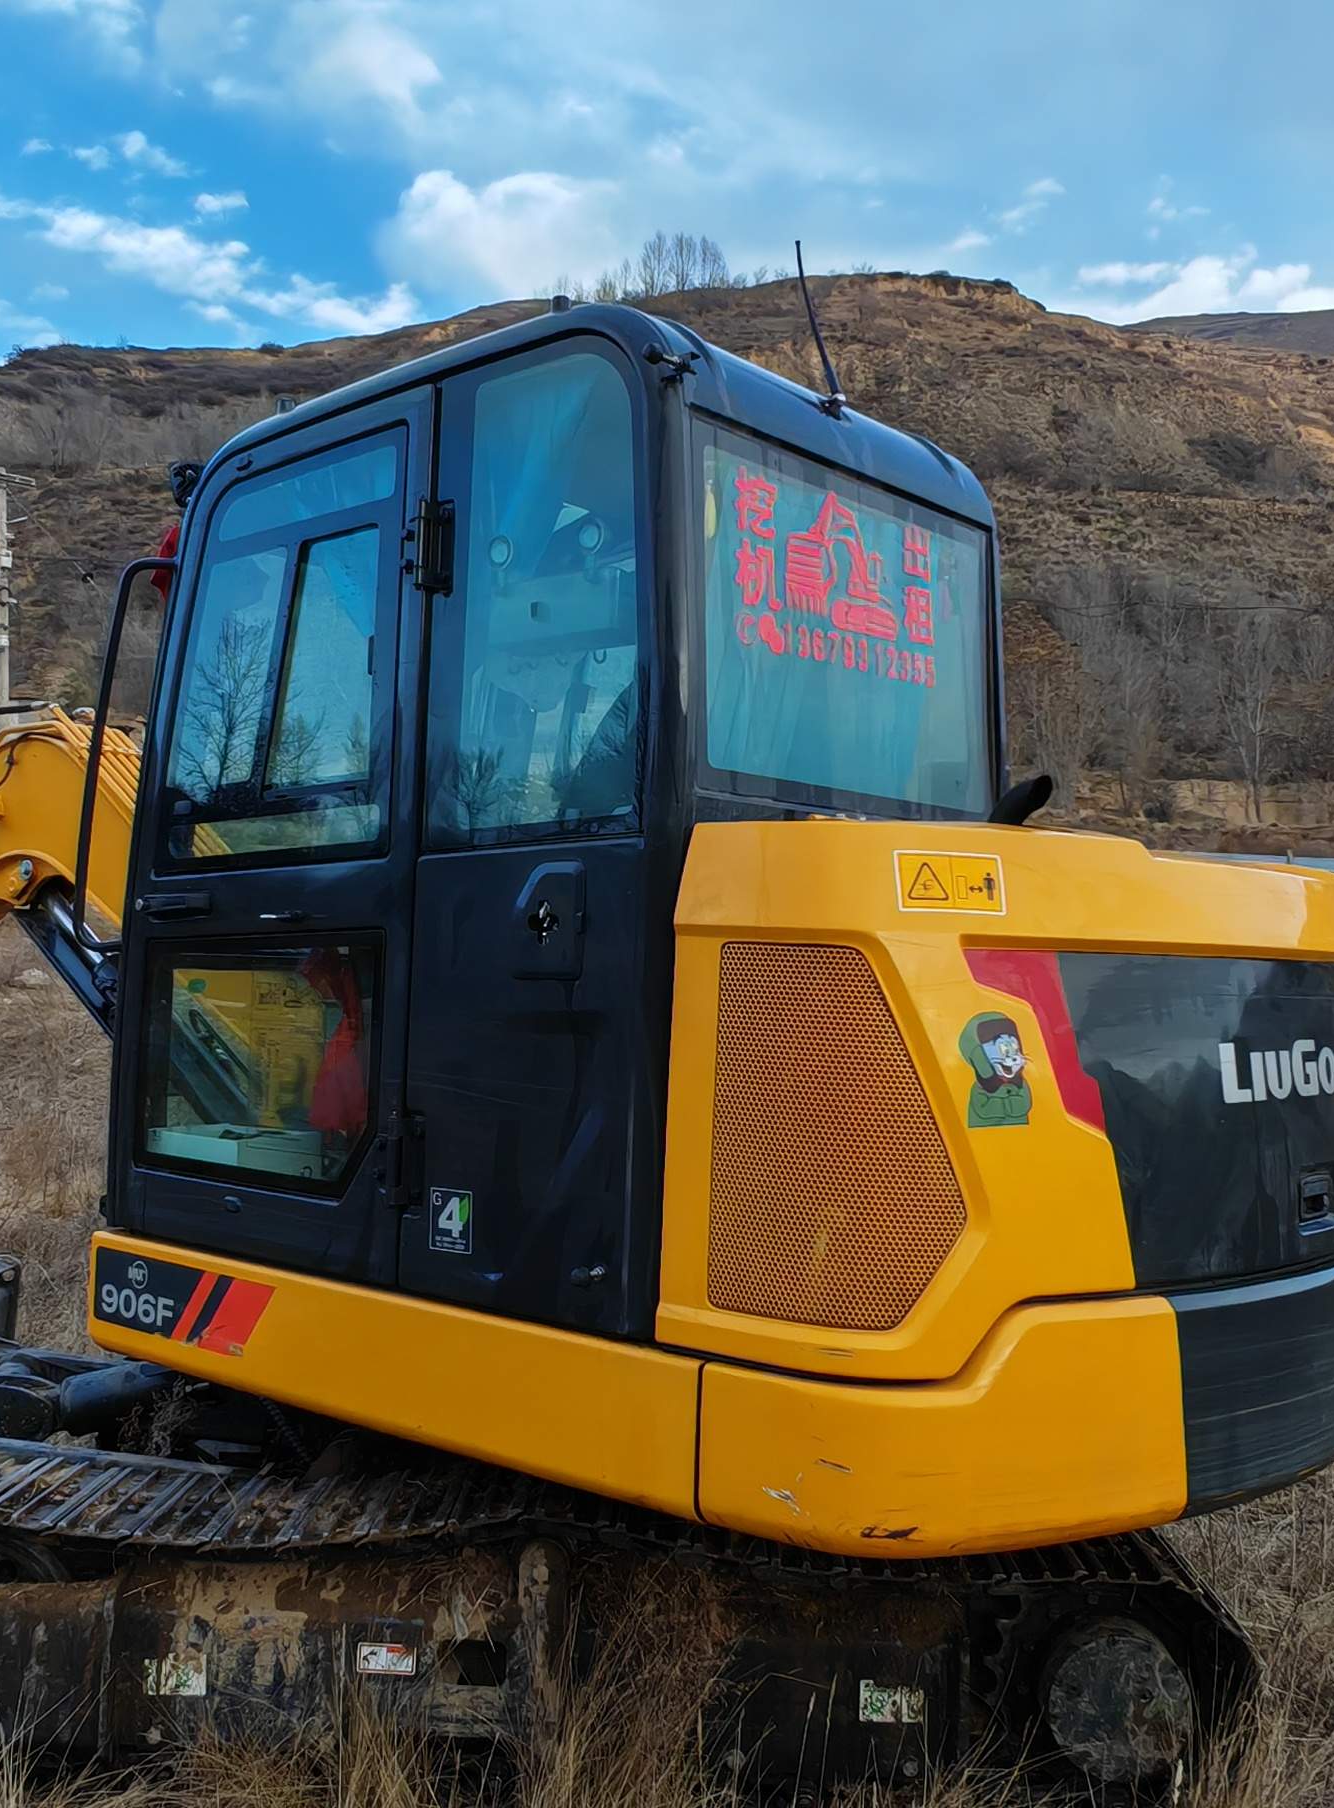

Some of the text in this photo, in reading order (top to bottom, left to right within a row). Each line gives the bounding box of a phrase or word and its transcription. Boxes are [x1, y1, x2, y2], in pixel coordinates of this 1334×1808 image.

[734, 465, 782, 612] 挖机
[902, 523, 935, 646] 出租
[433, 1191, 442, 1205] G
[438, 1196, 463, 1238] 4
[101, 1283, 175, 1327] 906F
